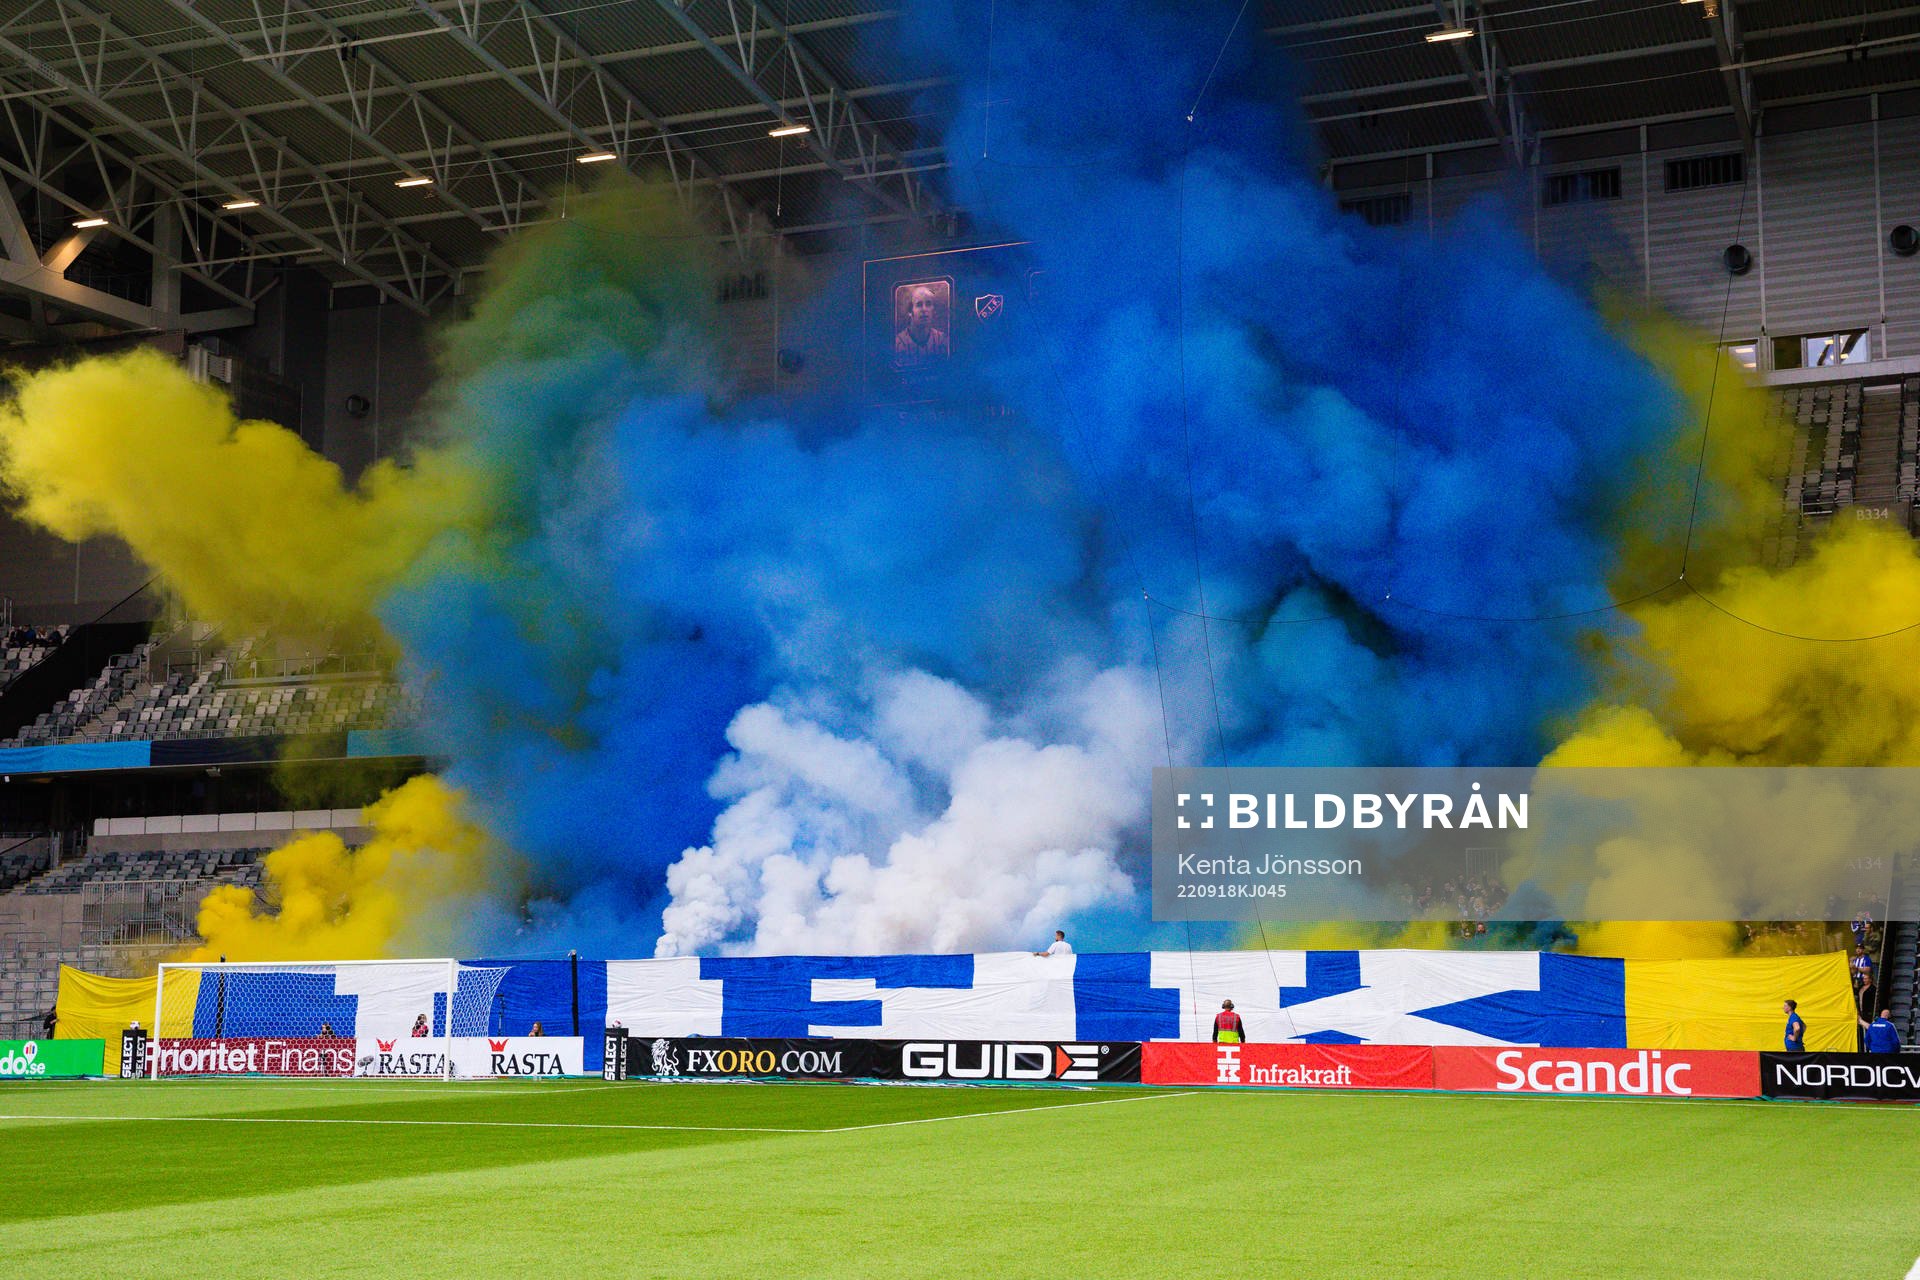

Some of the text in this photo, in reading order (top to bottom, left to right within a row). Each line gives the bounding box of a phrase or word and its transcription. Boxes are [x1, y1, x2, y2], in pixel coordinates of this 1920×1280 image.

[1856, 507, 1888, 521] B334
[122, 1036, 133, 1078] SELECT
[135, 1036, 145, 1079] SELECT
[144, 1041, 353, 1072] Prioritet Finans
[490, 1053, 565, 1075] RASTA
[604, 1036, 617, 1081] SELECT
[619, 1037, 628, 1080] SELECT
[686, 1049, 842, 1073] FXORO.COM
[902, 1043, 1099, 1080] GUIDE
[1249, 1064, 1352, 1085] Infrakraft
[1496, 1050, 1692, 1094] Scandic
